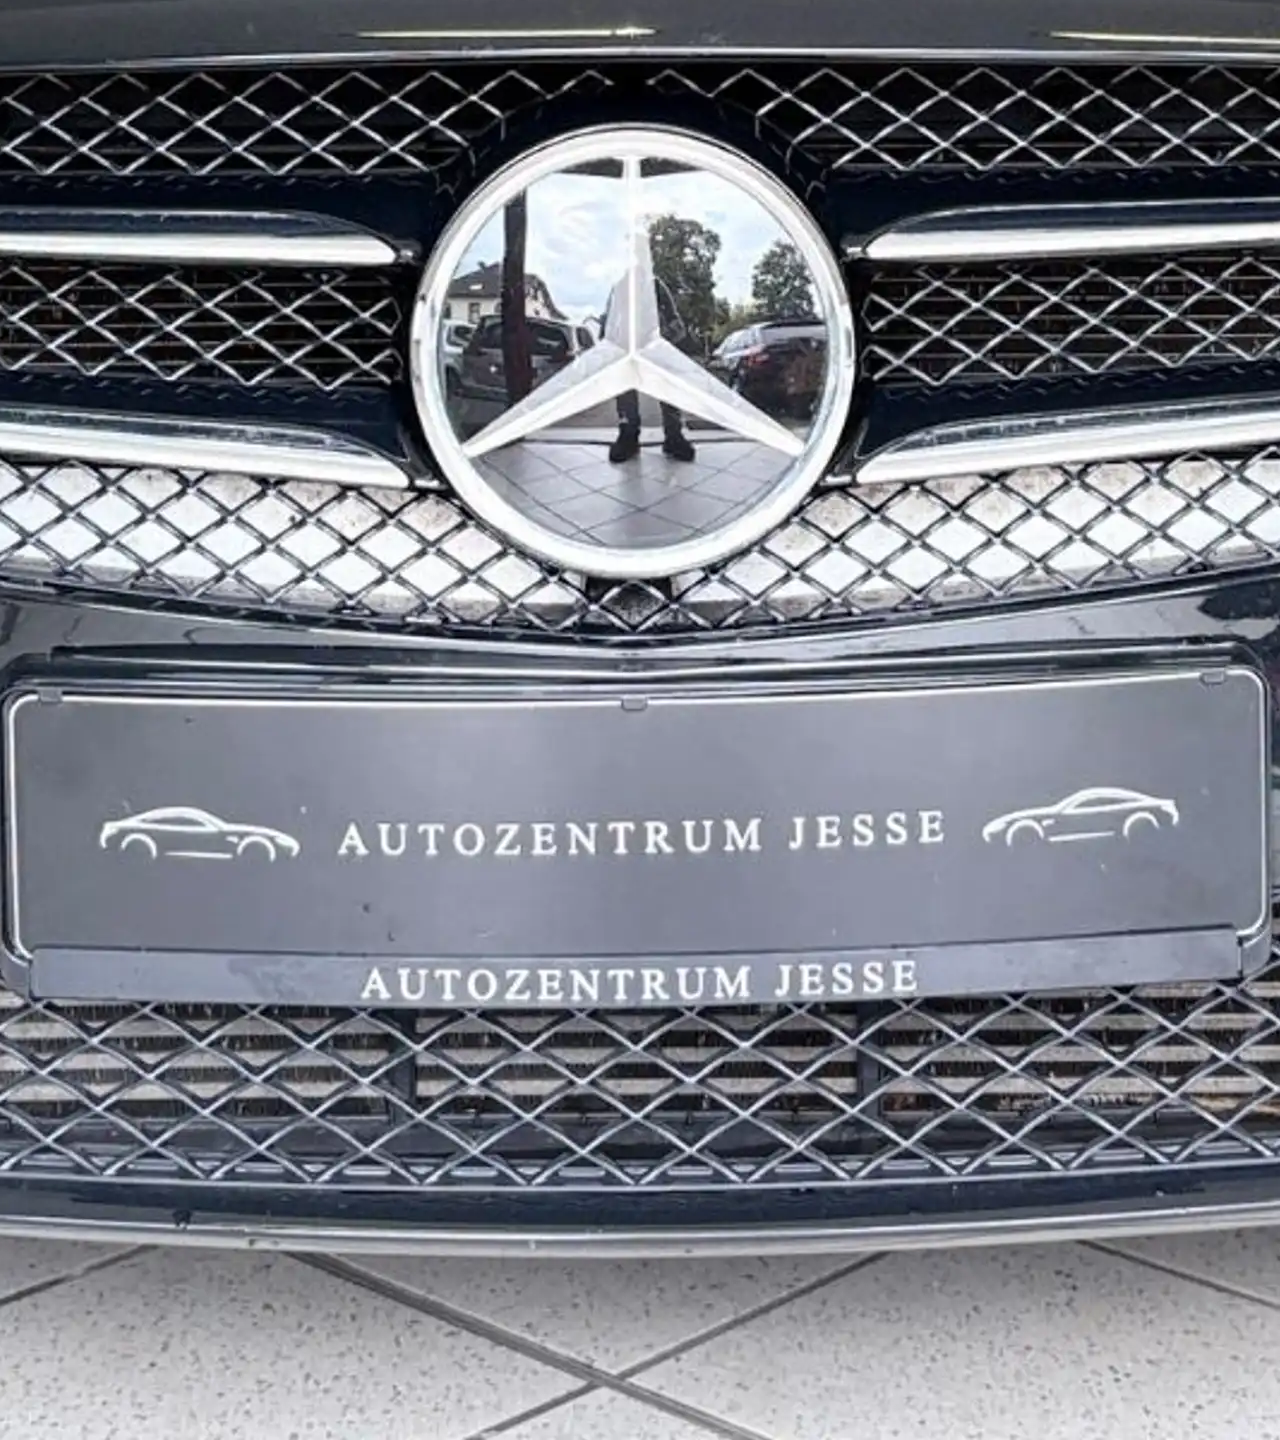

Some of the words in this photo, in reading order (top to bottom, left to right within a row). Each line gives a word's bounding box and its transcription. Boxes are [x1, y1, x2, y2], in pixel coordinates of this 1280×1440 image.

[336, 818, 763, 858] AUTOZENTRUM
[788, 810, 945, 851] JESSE
[360, 965, 752, 1004] AUTOZENTRUM
[773, 959, 918, 999] JESSE
